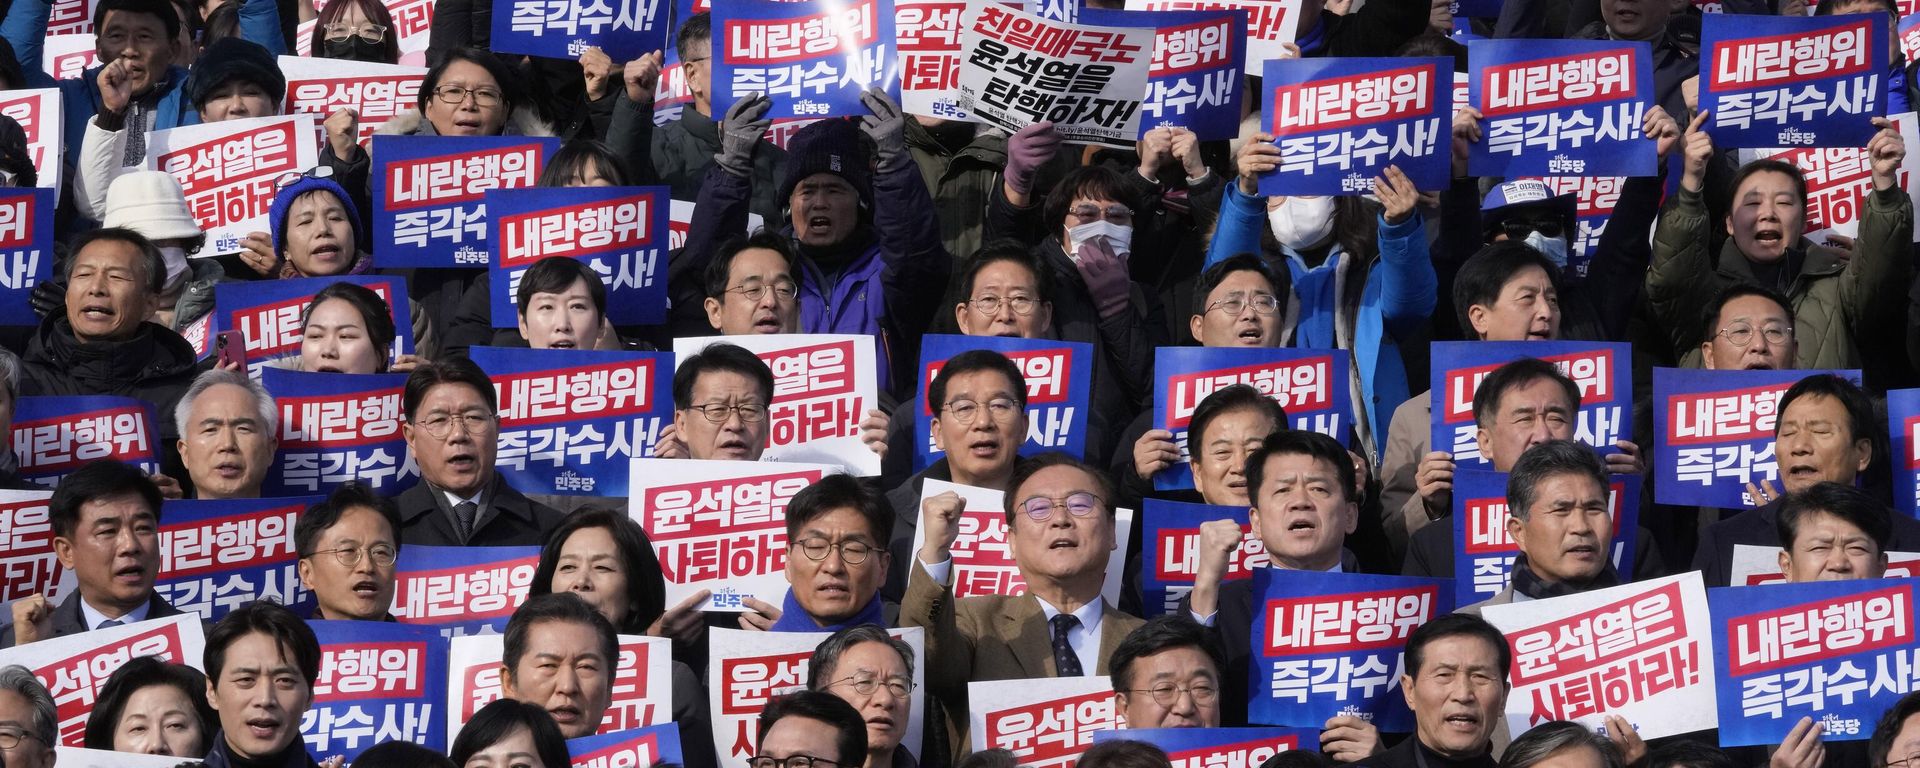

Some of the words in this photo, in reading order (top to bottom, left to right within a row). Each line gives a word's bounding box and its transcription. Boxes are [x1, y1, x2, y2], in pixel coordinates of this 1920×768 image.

[512, 0, 658, 37] 즉각수사!
[732, 3, 871, 60] 내란행위
[895, 8, 963, 46] 윤석
[972, 6, 1143, 63] 친일매국노
[732, 44, 885, 98] 즉각수사!
[968, 38, 1115, 95] 윤석열을
[1151, 23, 1229, 71] 행위
[1718, 27, 1866, 84] 내란행위
[980, 76, 1133, 130] 탄핵하자!
[1142, 68, 1236, 118] 각수사!
[1280, 71, 1428, 128] 내란행위
[1489, 54, 1630, 109] 내란행위
[1716, 74, 1878, 130] 즉각수사!
[793, 103, 830, 115] 민주당
[1489, 102, 1645, 157] 즉각수사!
[164, 128, 288, 190] 윤석열은
[1280, 117, 1440, 175] 즉각수사!
[1778, 132, 1816, 145] 민주당
[393, 149, 535, 203] 내란행위
[1549, 160, 1586, 174] 민주당
[216, 238, 247, 253] 민주
[393, 203, 487, 247] 즉각수
[507, 200, 647, 259] 내란행위
[493, 365, 647, 420] 내란행위
[765, 347, 845, 395] 열은
[283, 393, 406, 442] 내란행
[495, 417, 661, 471] 즉각수사!
[765, 397, 863, 449] 하라!
[555, 476, 595, 491] 민주당
[1676, 441, 1779, 486] 즉각수
[653, 478, 810, 535] 윤석열은
[951, 517, 1015, 560] 윤석
[713, 594, 754, 608] 민주
[1272, 592, 1431, 648] 내란행위
[1515, 593, 1676, 679] 윤석열은
[1737, 593, 1906, 667] 내란행위
[38, 634, 172, 707] 석열은
[314, 648, 418, 695] 행위
[730, 658, 810, 707] 윤석
[1271, 652, 1405, 704] 즉각수
[1529, 640, 1700, 727] 사퇴하라!
[1742, 648, 1920, 719] 즉각수사!
[299, 702, 432, 752] 각수사!
[996, 698, 1127, 758] 윤석열
[1816, 719, 1861, 735] 민주당
